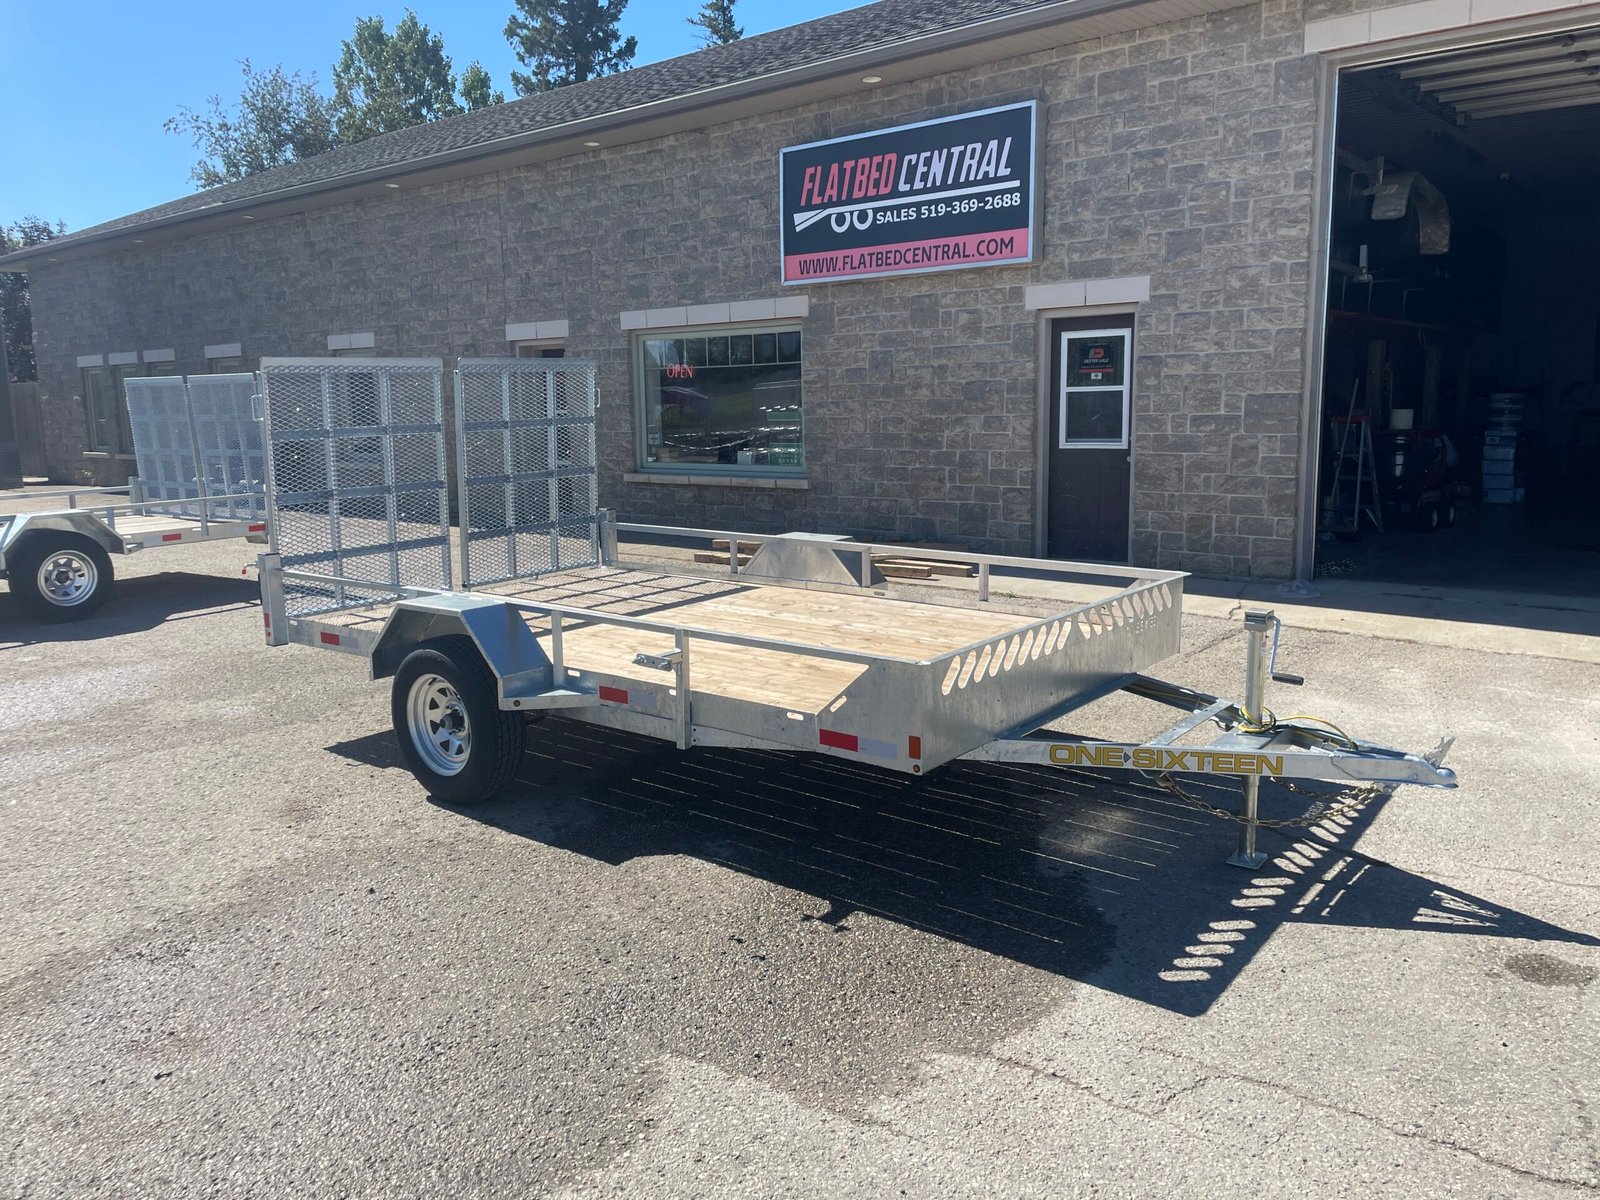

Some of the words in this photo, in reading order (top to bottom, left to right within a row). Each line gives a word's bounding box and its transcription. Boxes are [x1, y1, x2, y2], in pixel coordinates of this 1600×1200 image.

[800, 153, 897, 206] FLATBED
[898, 137, 1012, 192] CENTRAL
[876, 208, 917, 225] SALES
[920, 192, 1021, 218] 519-369-2688
[799, 236, 1014, 275] WWW.FLATBEDCENTRAL.COM
[666, 363, 693, 378] OPEN
[1050, 744, 1124, 766] ONE
[1132, 749, 1283, 775] SIXTEEN
